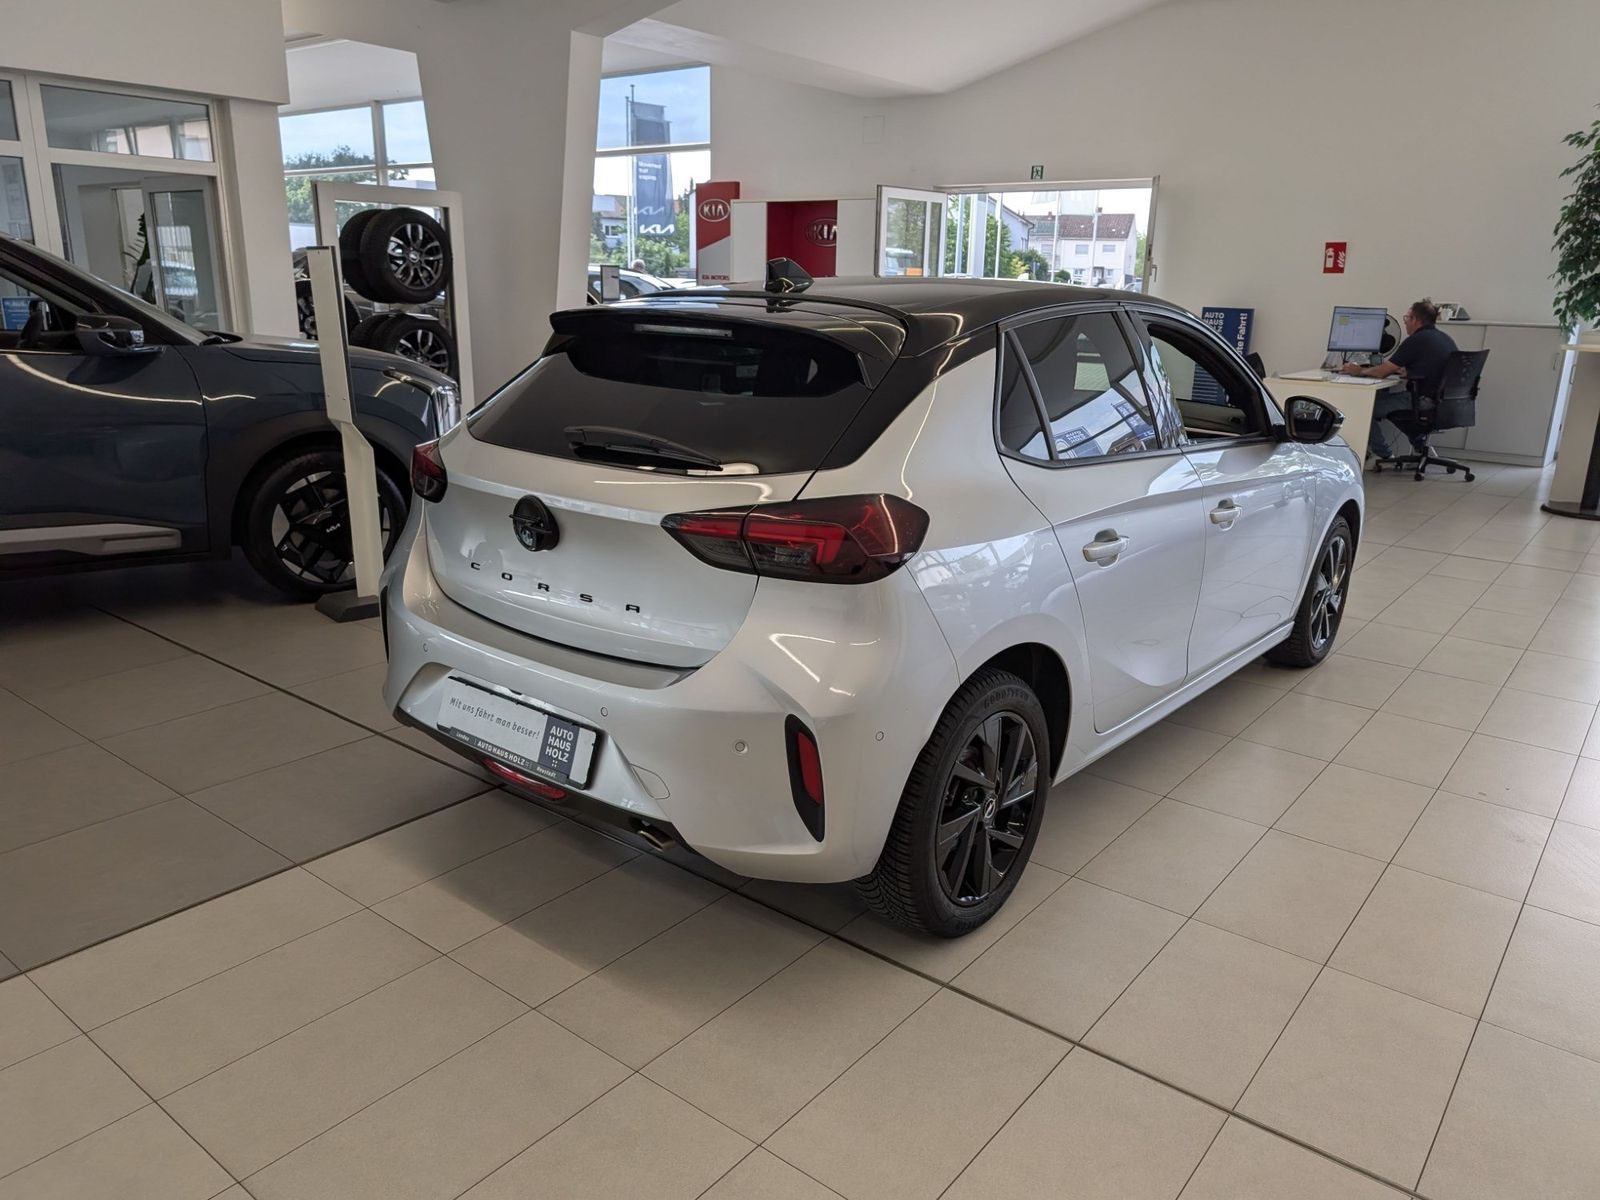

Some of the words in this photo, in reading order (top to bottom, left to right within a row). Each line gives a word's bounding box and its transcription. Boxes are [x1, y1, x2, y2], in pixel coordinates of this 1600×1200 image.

[703, 203, 725, 217] KIA
[813, 224, 838, 241] KIA
[1237, 313, 1248, 340] Fahrt!
[1236, 341, 1244, 355] ute
[470, 562, 641, 613] CORSA
[450, 697, 462, 709] Mit
[462, 704, 475, 714] uns
[473, 706, 495, 722] fährt
[495, 716, 511, 728] man
[511, 721, 541, 740] besser!
[550, 725, 574, 740] AUTO
[547, 736, 571, 752] HAUS
[508, 752, 526, 766] HOLZ
[545, 746, 569, 763] HOLZ
